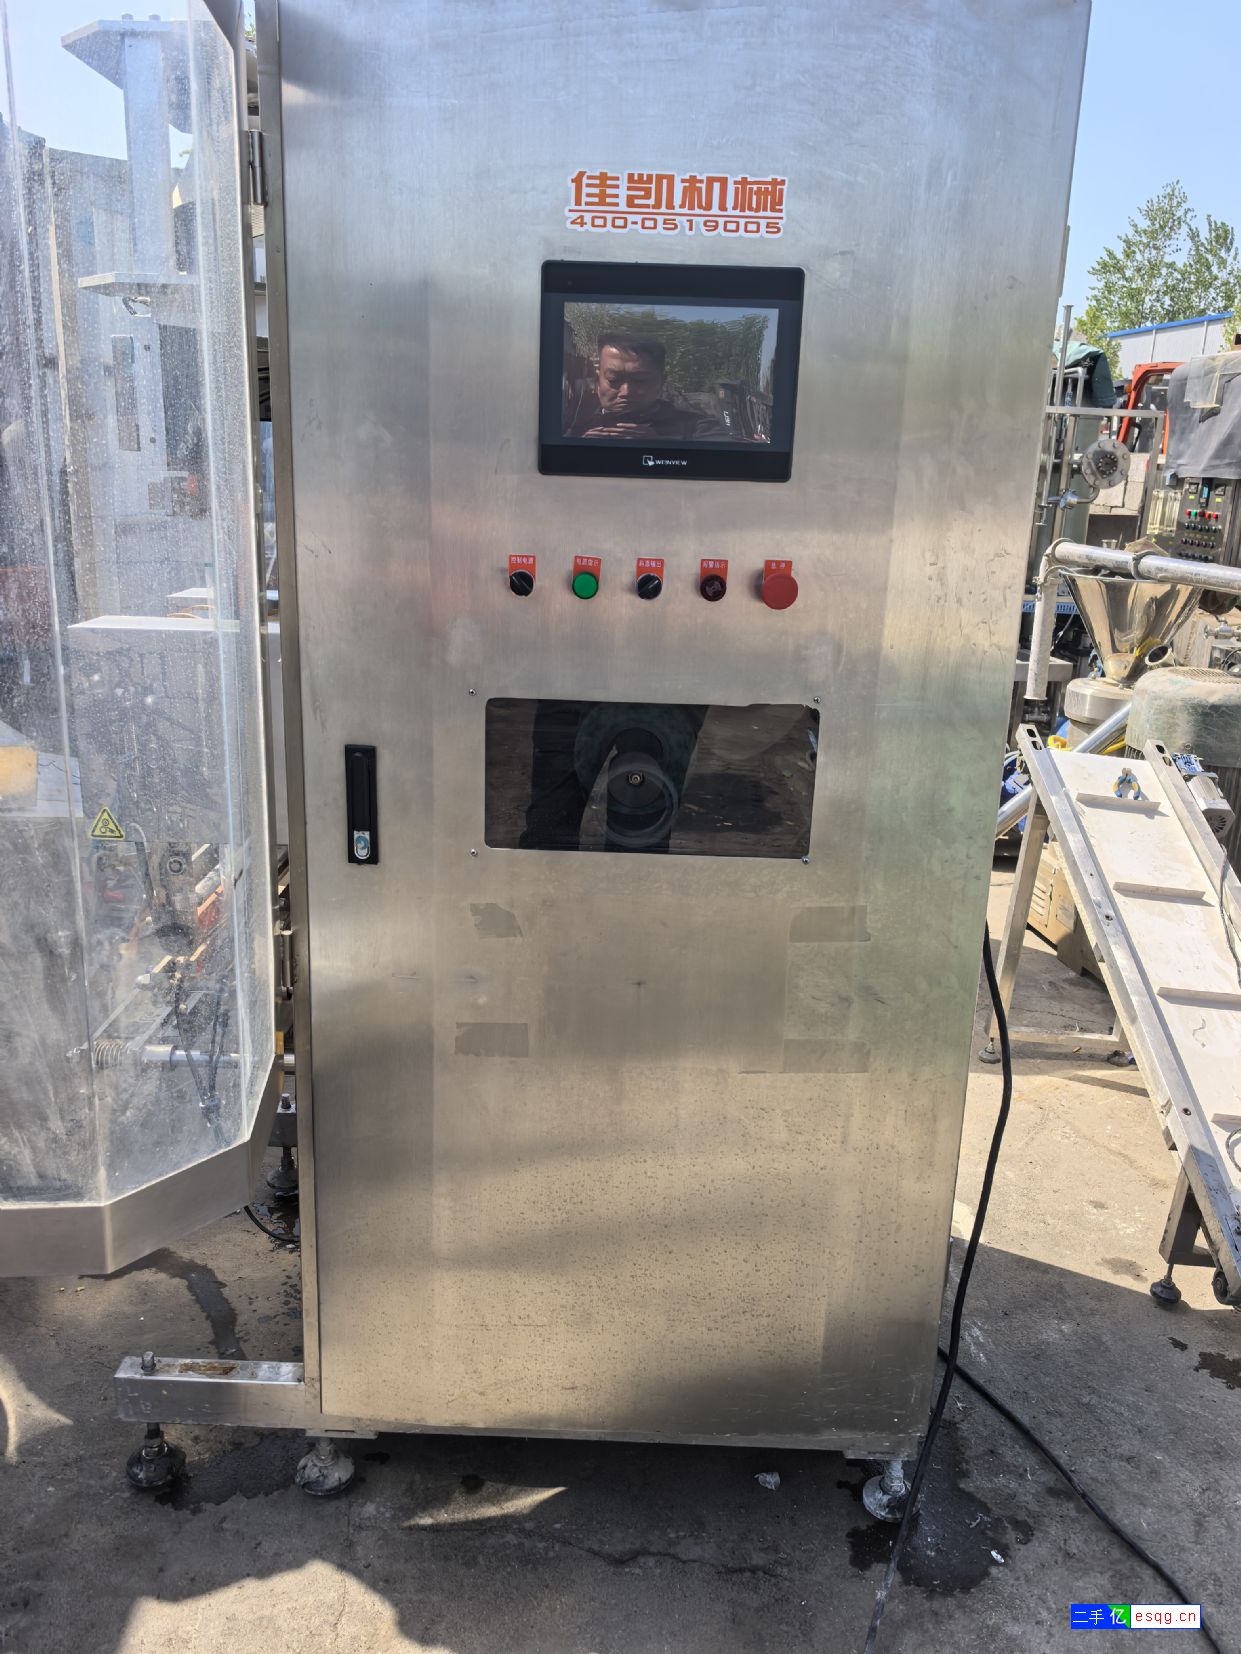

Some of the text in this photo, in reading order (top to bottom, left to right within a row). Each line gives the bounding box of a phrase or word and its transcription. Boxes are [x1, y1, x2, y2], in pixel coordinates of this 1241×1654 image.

[571, 171, 787, 213] 佳凯机械
[570, 215, 782, 235] 400-0519005
